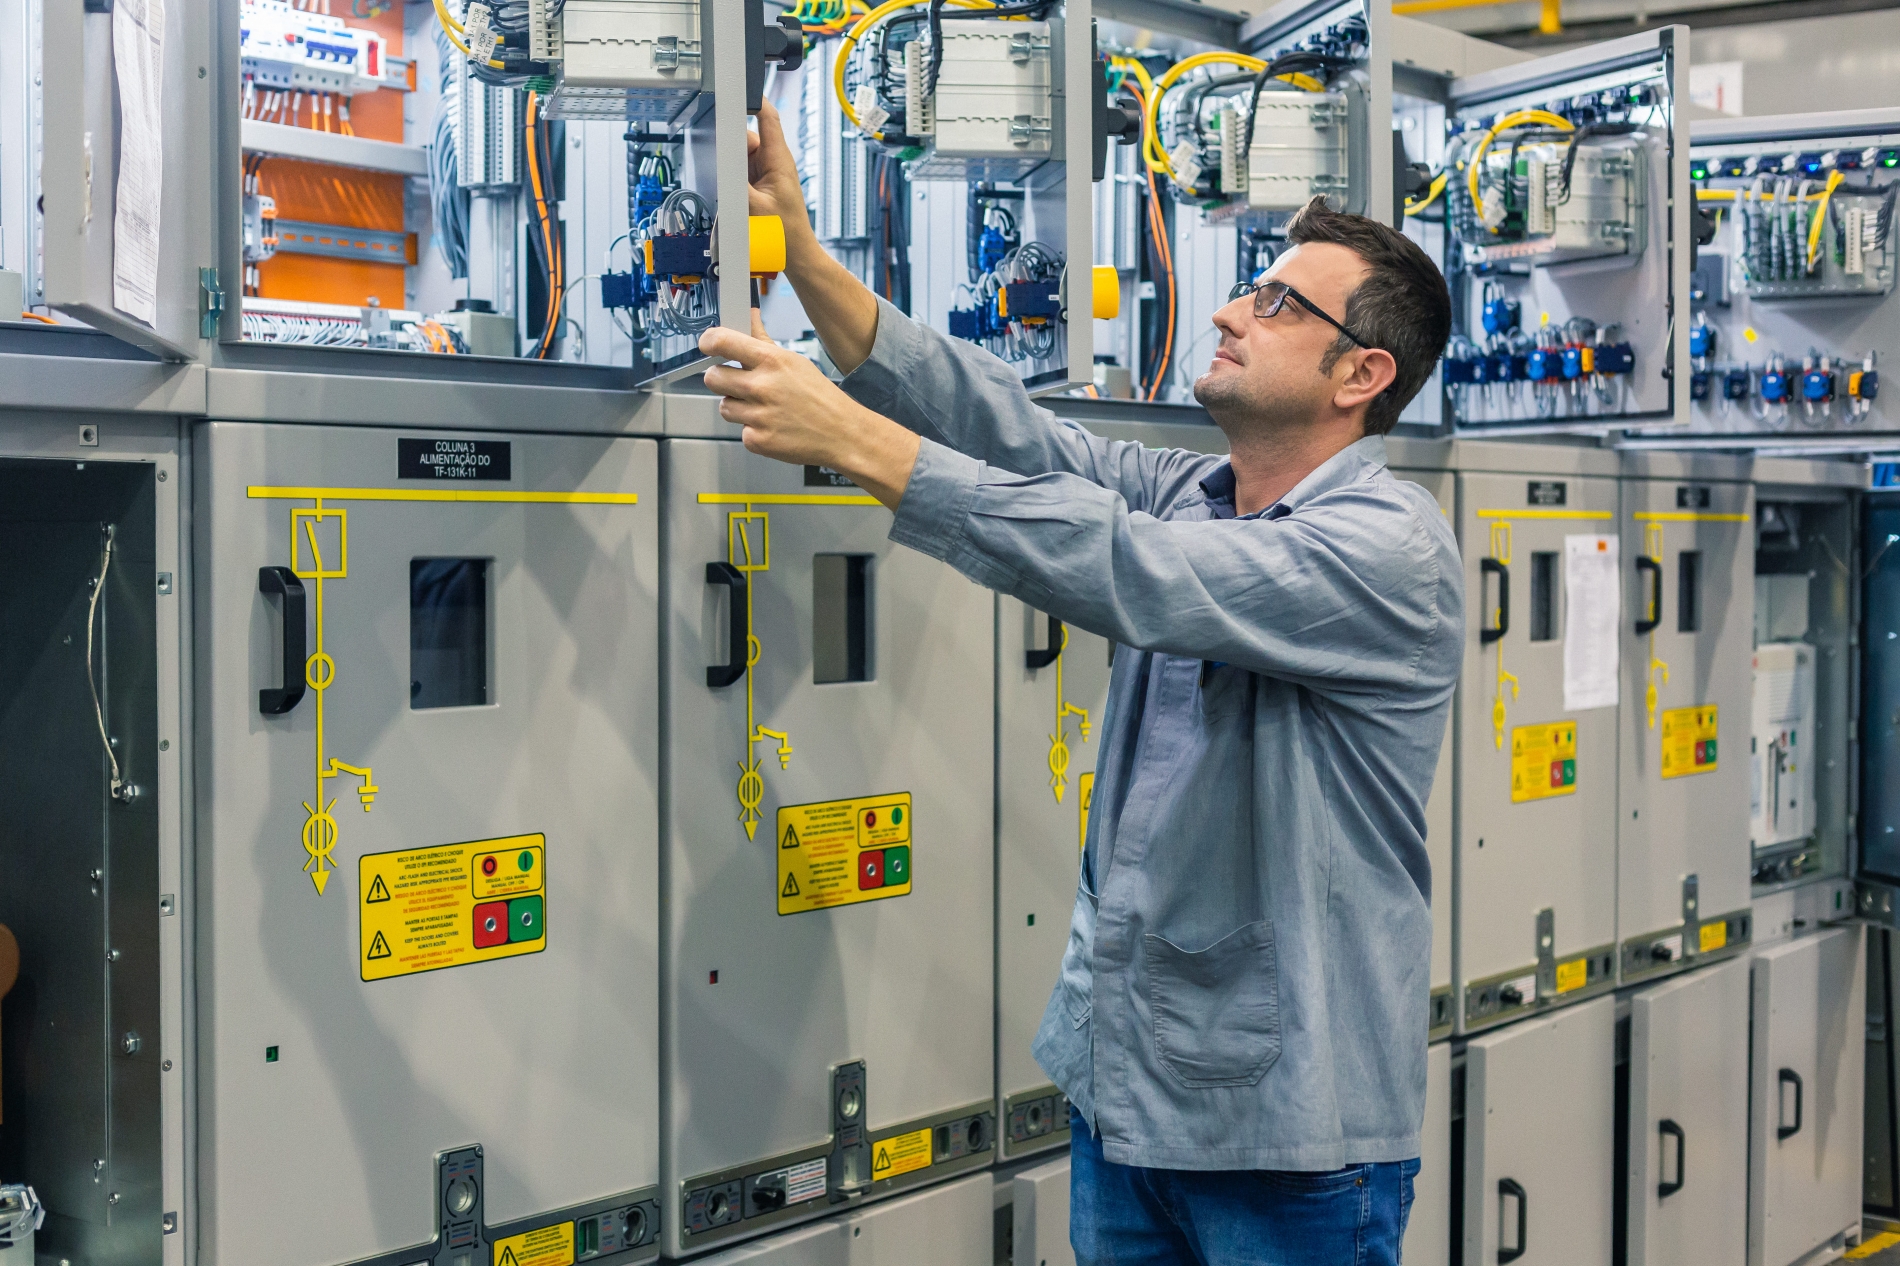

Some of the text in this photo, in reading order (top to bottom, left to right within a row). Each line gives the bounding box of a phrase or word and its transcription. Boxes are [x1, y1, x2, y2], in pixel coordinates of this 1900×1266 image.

[484, 36, 494, 54] ETH1
[435, 442, 475, 453] COLUNA 3
[420, 452, 490, 466] ALIMENTAÇÃO DO
[434, 466, 476, 477] TF-131K-11
